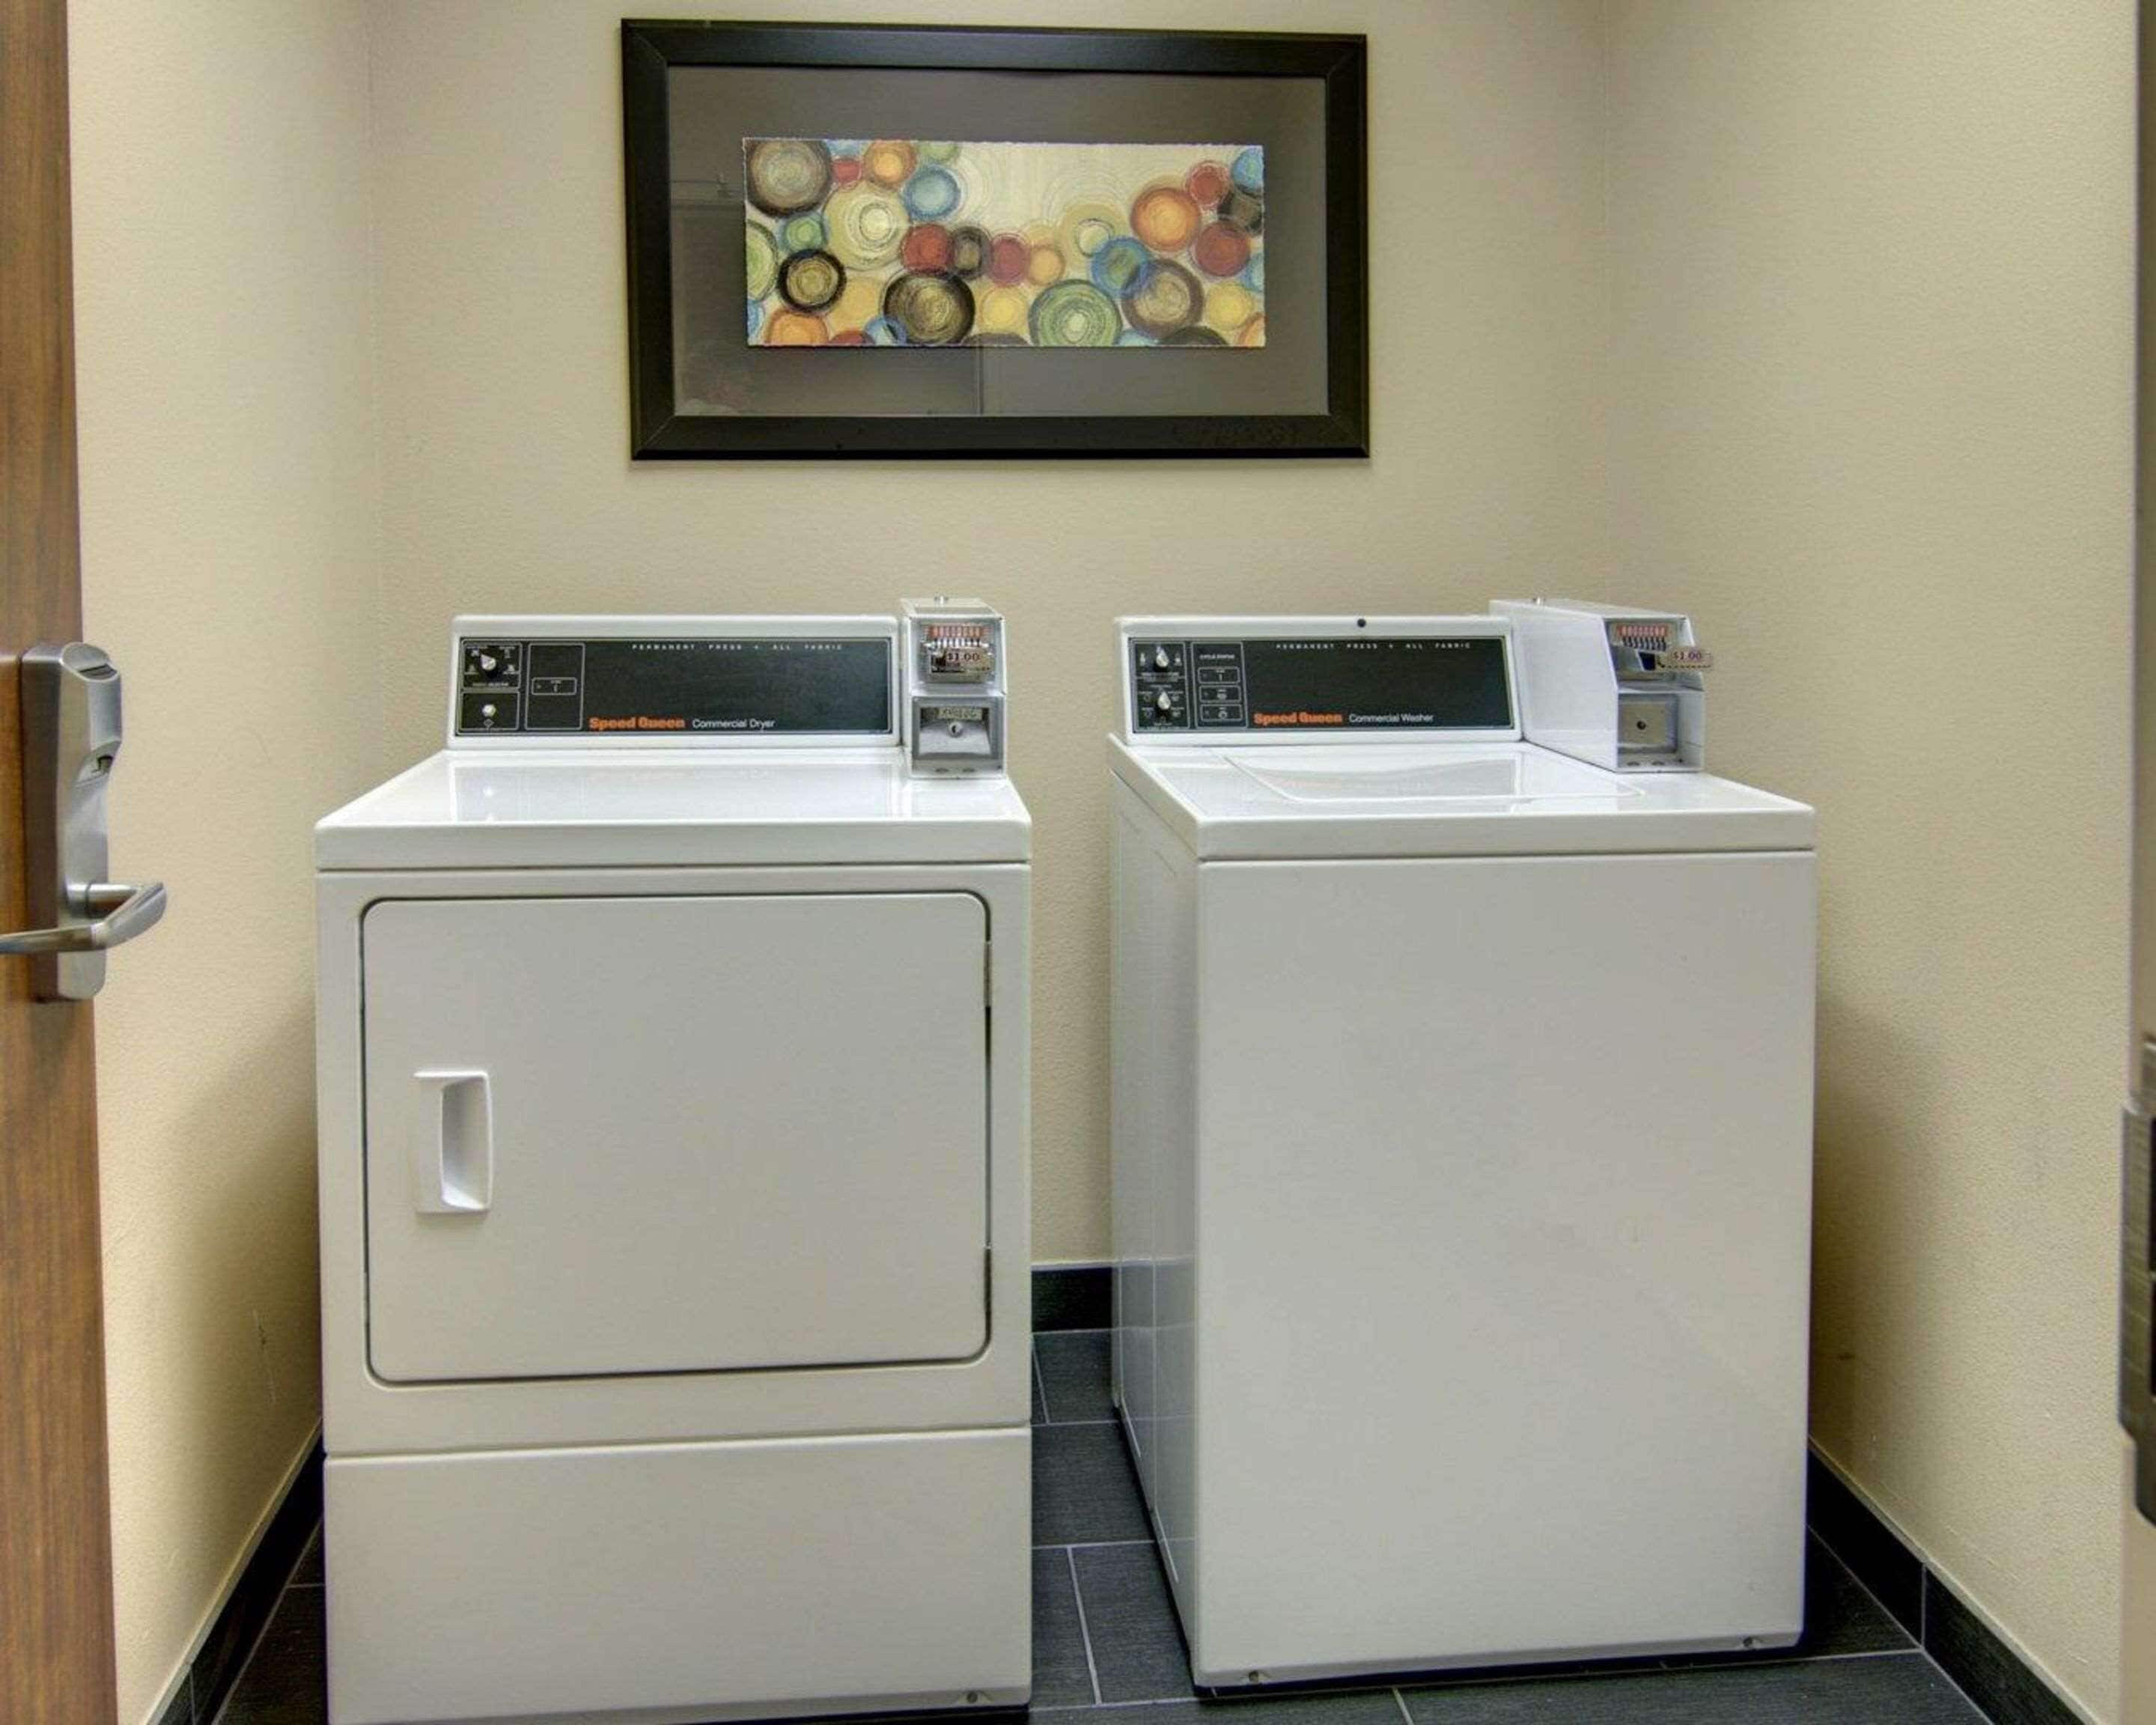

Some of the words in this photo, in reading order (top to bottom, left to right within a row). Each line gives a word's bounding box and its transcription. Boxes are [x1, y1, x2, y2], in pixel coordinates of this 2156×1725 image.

[588, 717, 636, 731] Speed
[637, 716, 686, 729] Queen
[692, 718, 748, 728] Commercial
[749, 718, 776, 733] Dryer
[1253, 711, 1297, 726] Speed
[1298, 711, 1343, 724] Queen
[1348, 713, 1399, 723] Commercial
[1400, 713, 1434, 723] Washer
